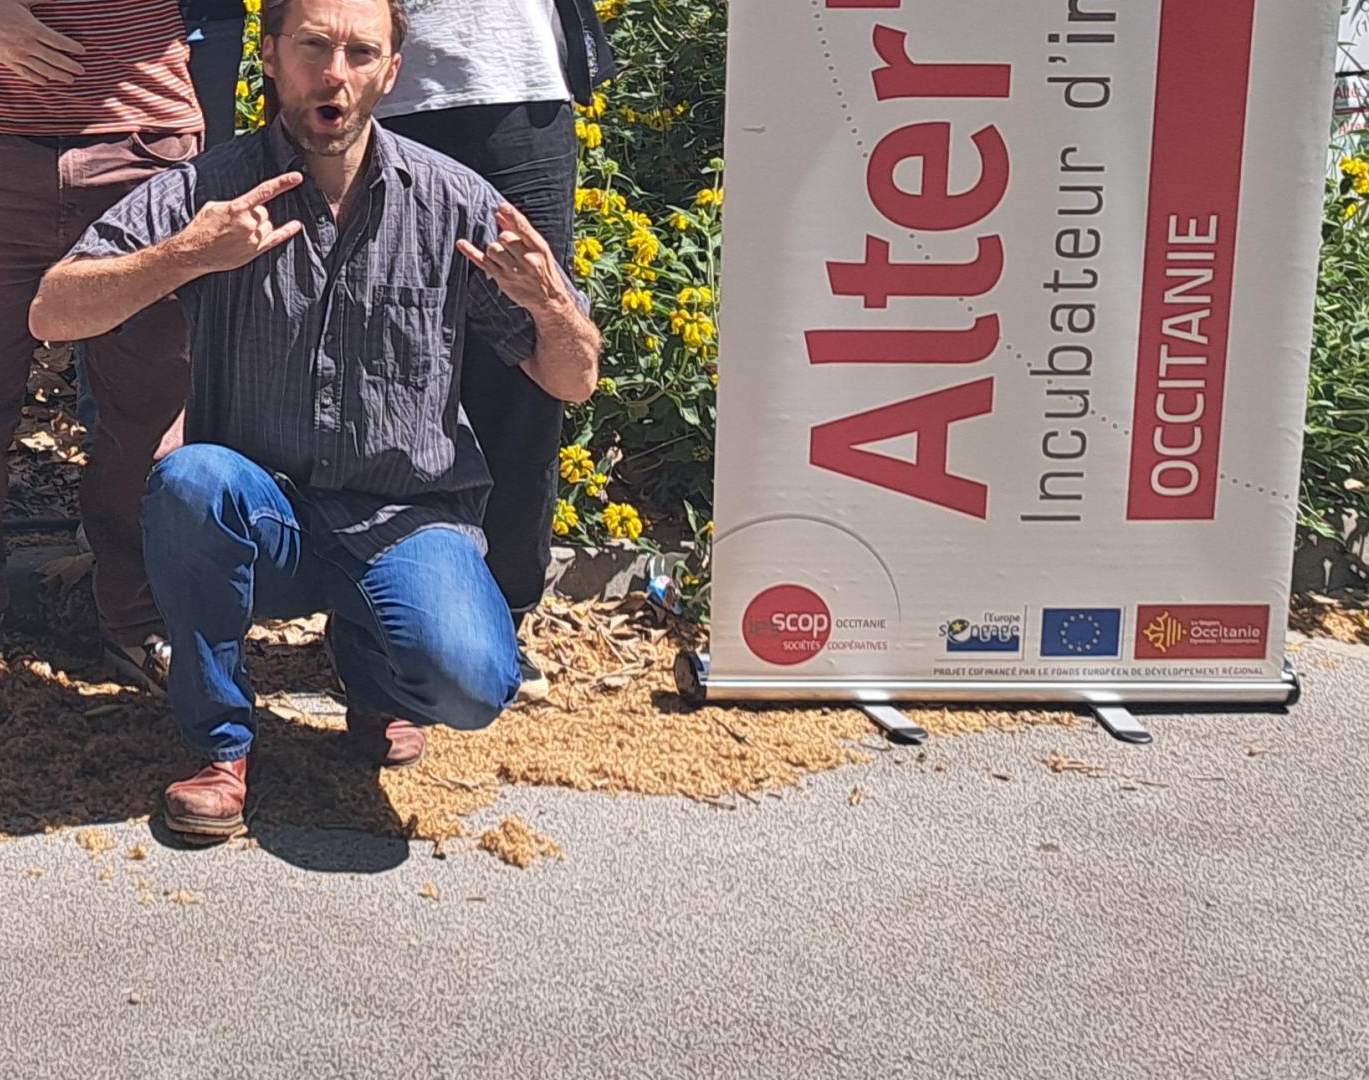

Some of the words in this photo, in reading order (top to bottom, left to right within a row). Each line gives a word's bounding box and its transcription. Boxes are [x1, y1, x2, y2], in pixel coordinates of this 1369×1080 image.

[1020, 146, 1106, 522] Incubateur
[1150, 214, 1219, 497] OCCITANIE
[772, 612, 829, 639] scop
[836, 619, 886, 629] OCCITANIE
[1190, 625, 1261, 638] Occitanie
[783, 639, 821, 651] SOCIÉTÉS
[828, 640, 888, 651] COOPÉRATIVES
[933, 667, 966, 677] PROJET
[968, 666, 1016, 677] COFINANCÉ
[1019, 668, 1036, 677] PAR
[1038, 668, 1048, 677] LE
[1051, 667, 1079, 677] FONDS
[1082, 667, 1129, 677] EUROPÉEN
[1131, 668, 1142, 677] DE
[1145, 667, 1220, 677] DÉVELOPPEMENT
[1222, 666, 1264, 676] RÉGIONAL
